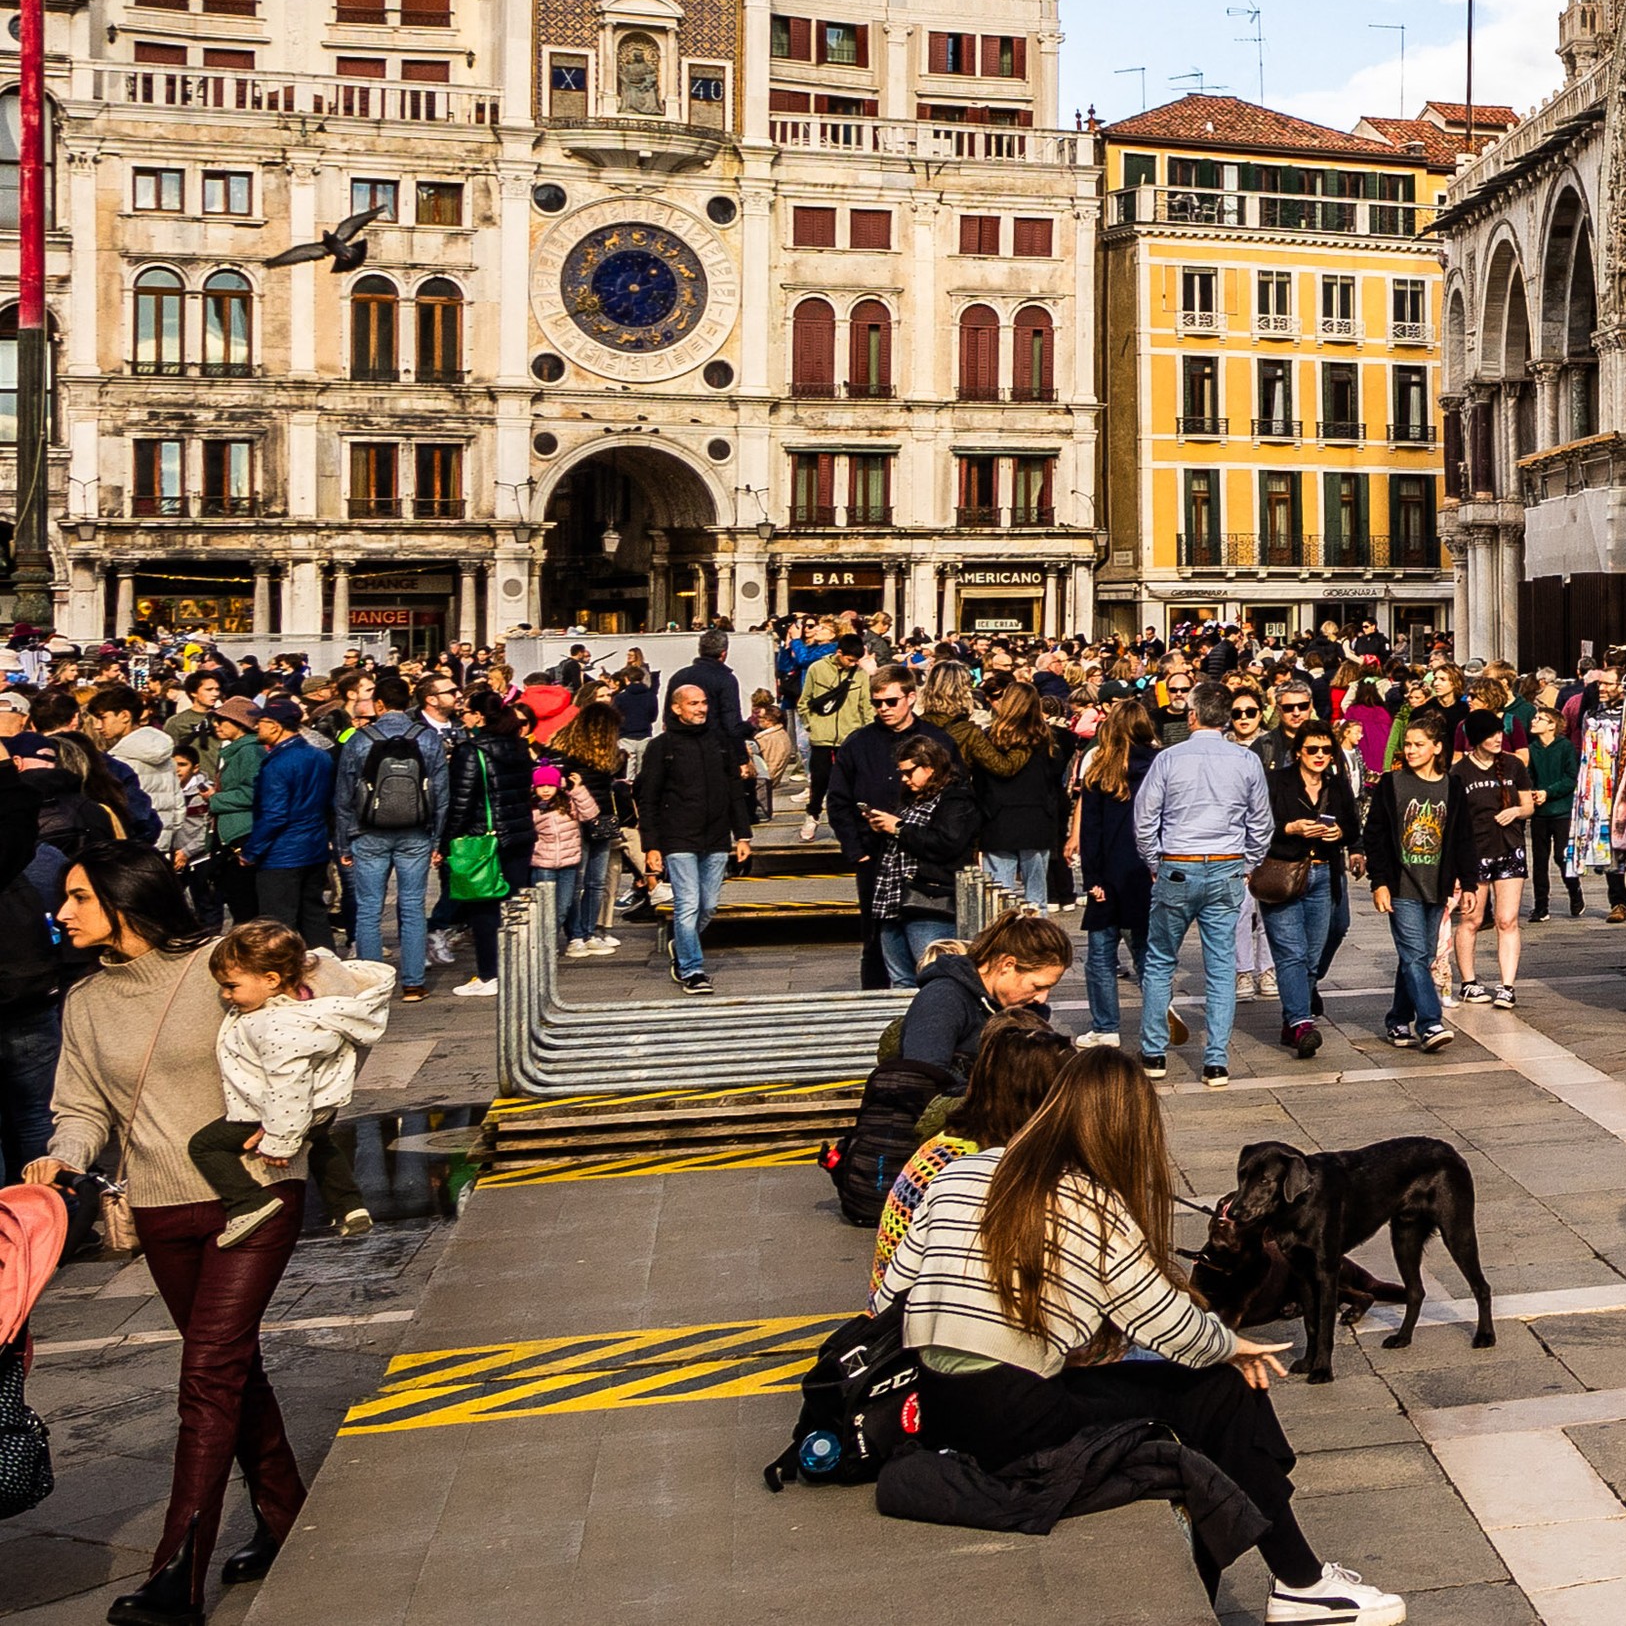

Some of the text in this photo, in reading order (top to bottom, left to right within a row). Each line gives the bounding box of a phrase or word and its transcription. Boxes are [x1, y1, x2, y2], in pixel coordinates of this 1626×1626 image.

[560, 68, 576, 90] X
[691, 79, 723, 100] 40
[353, 577, 419, 590] CHANGE
[812, 572, 855, 585] BAR
[956, 572, 1042, 584] AMERICANO
[348, 610, 408, 624] HANGE
